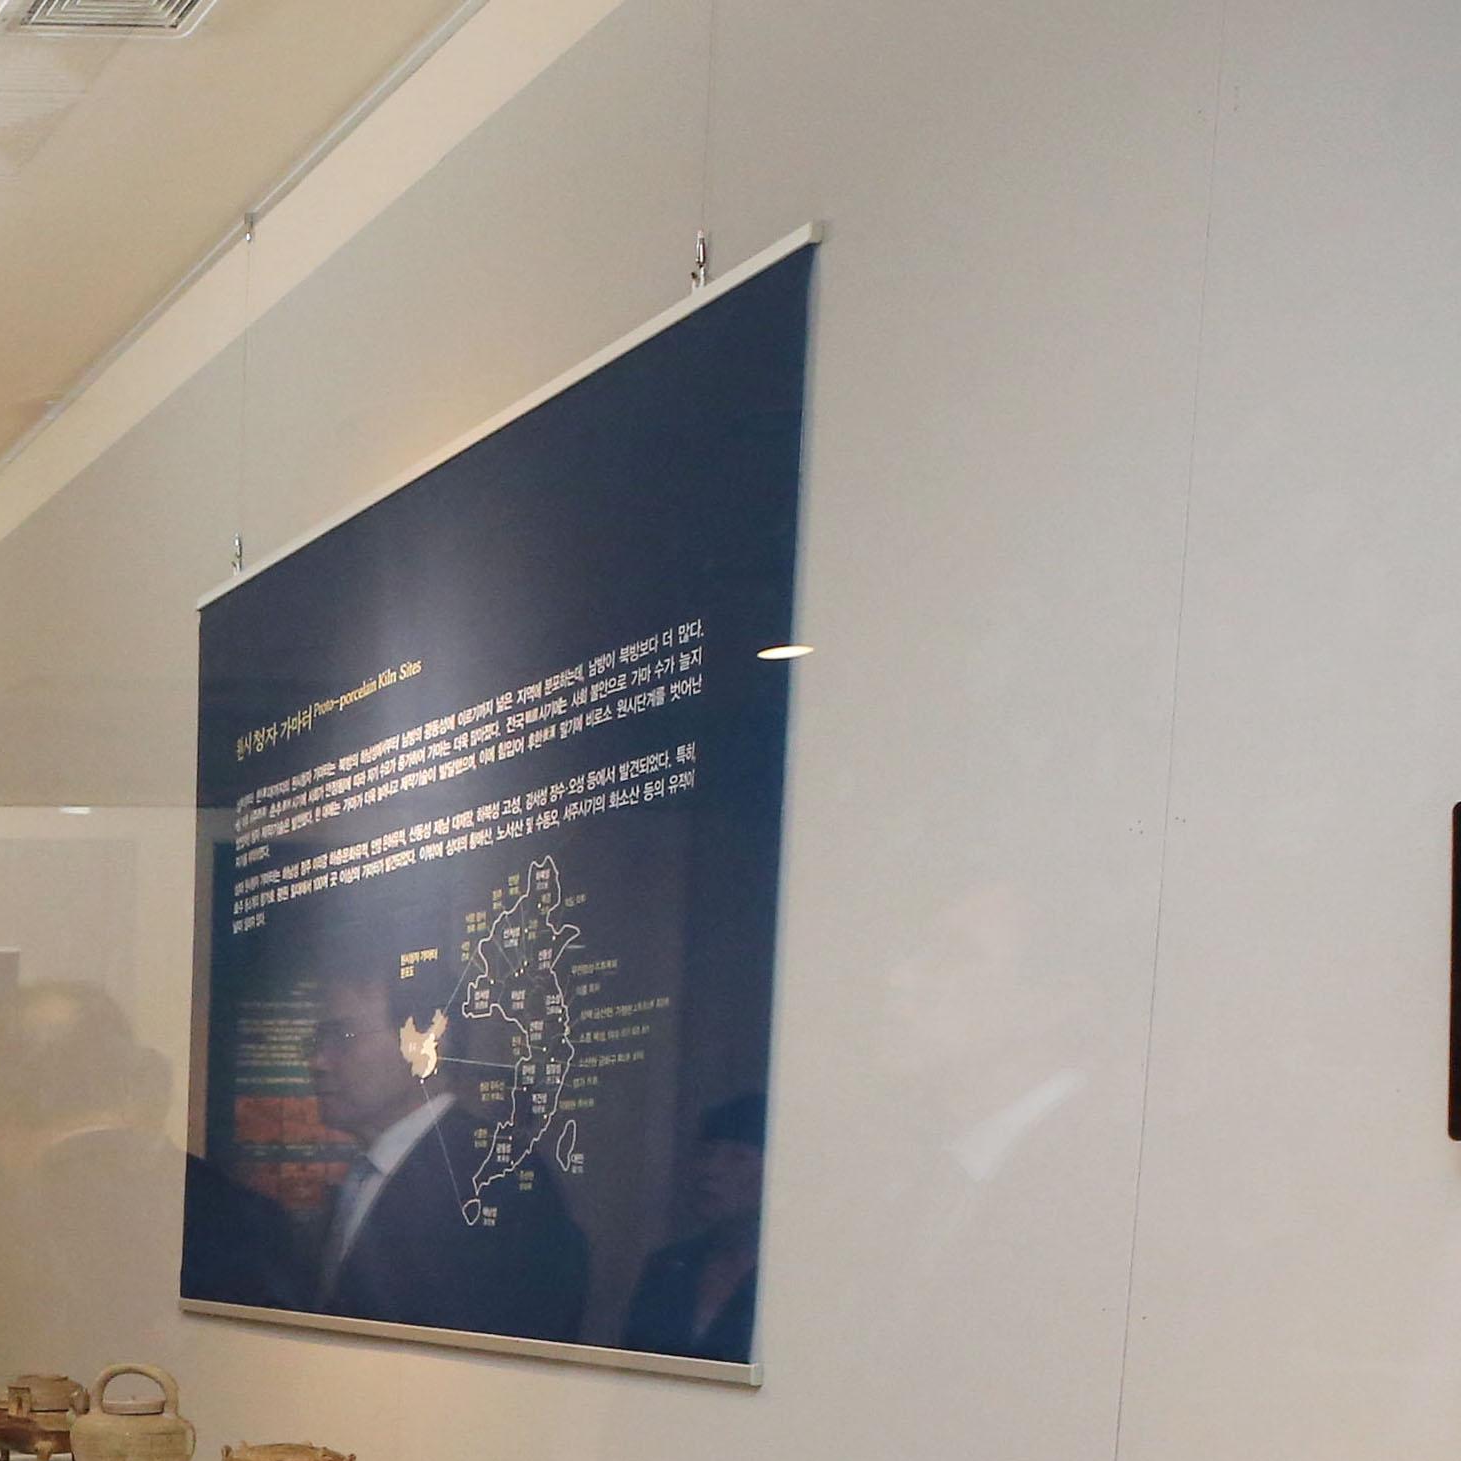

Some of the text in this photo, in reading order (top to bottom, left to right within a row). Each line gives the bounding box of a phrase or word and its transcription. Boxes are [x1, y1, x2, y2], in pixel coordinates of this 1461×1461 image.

[588, 653, 615, 676] 남방이
[618, 636, 658, 664] 북방보다
[662, 629, 673, 648] 더
[677, 619, 704, 644] 많다.
[279, 704, 312, 743] 가마터
[377, 667, 397, 689] Kiln
[398, 658, 422, 681] Sites
[452, 733, 469, 752] 더욱
[589, 674, 627, 702] 불안으로
[630, 665, 651, 686] 가마
[654, 655, 675, 679] 수가
[678, 648, 702, 670] 늘지
[585, 705, 613, 726] 비로소
[616, 686, 665, 718] 원시단계를
[669, 676, 702, 700] 벗어난
[501, 796, 522, 813] 고성,
[586, 767, 615, 790] 등에서
[618, 750, 671, 781] 발견되었다.
[608, 785, 639, 808] 화소산
[643, 779, 665, 801] 등의
[668, 769, 695, 793] 유적이
